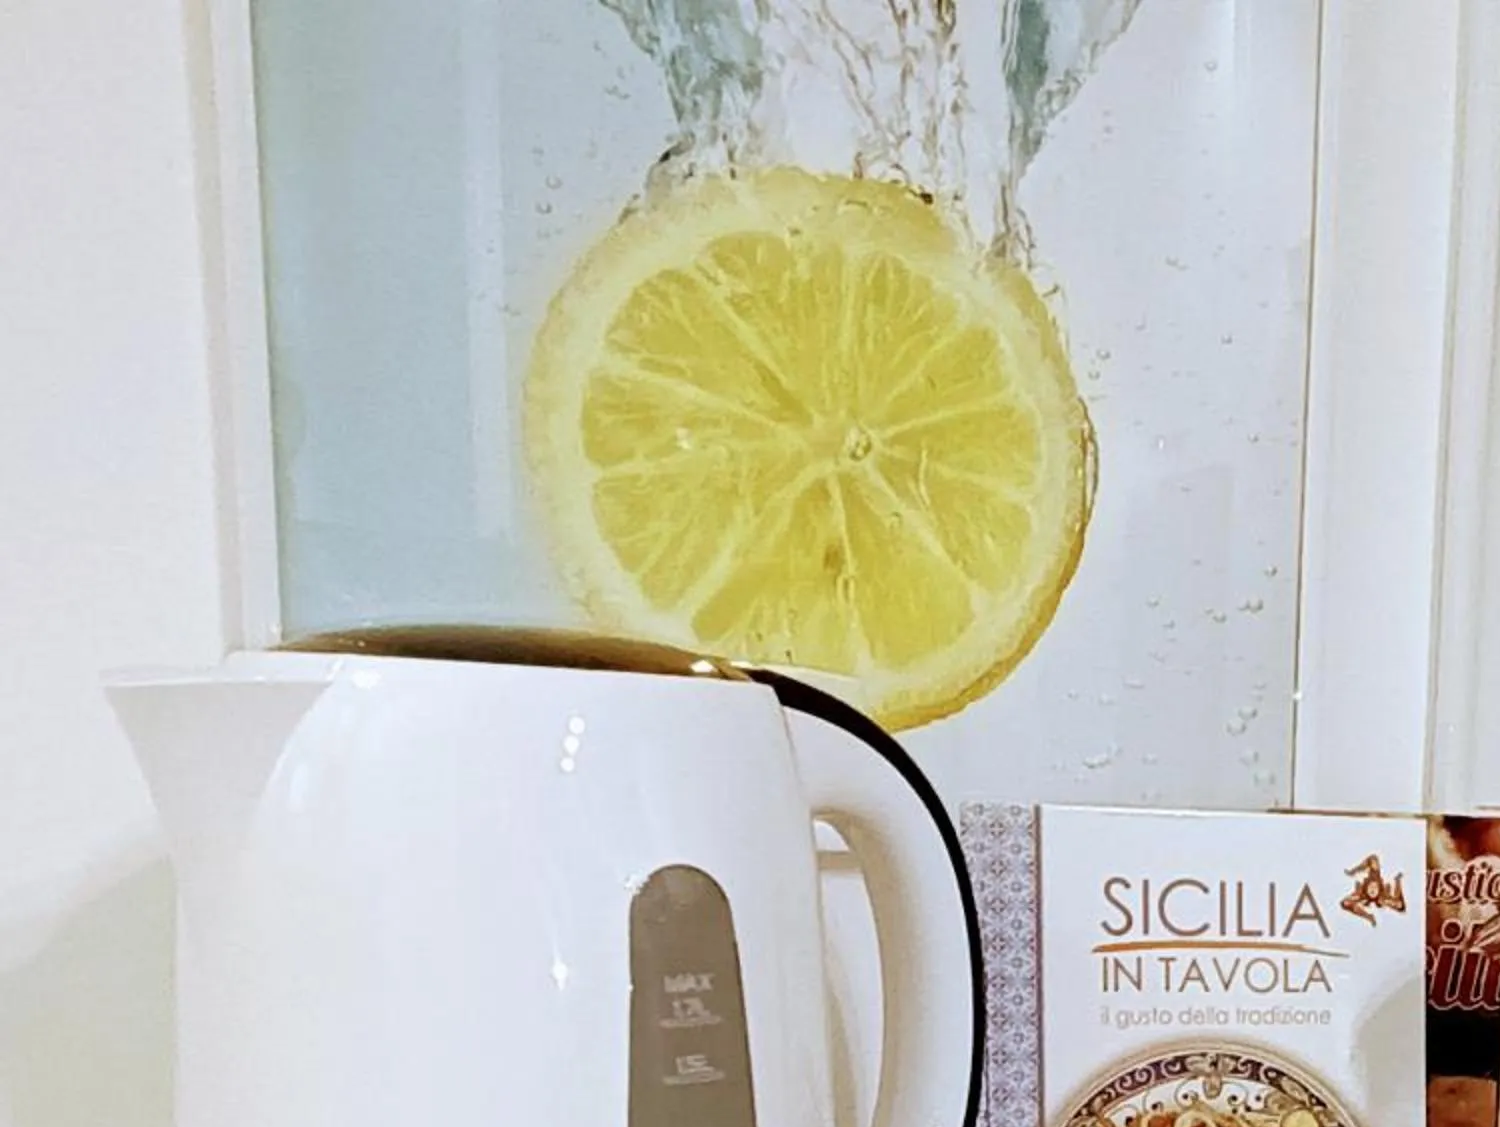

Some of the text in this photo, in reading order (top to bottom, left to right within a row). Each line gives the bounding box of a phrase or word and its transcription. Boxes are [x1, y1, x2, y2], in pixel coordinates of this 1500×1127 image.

[1100, 876, 1331, 939] SICILIA
[1101, 956, 1333, 994] IN TAVOLA
[1116, 1007, 1173, 1030] gusto
[1178, 1005, 1230, 1026] della
[1236, 1006, 1332, 1026] tradizione
